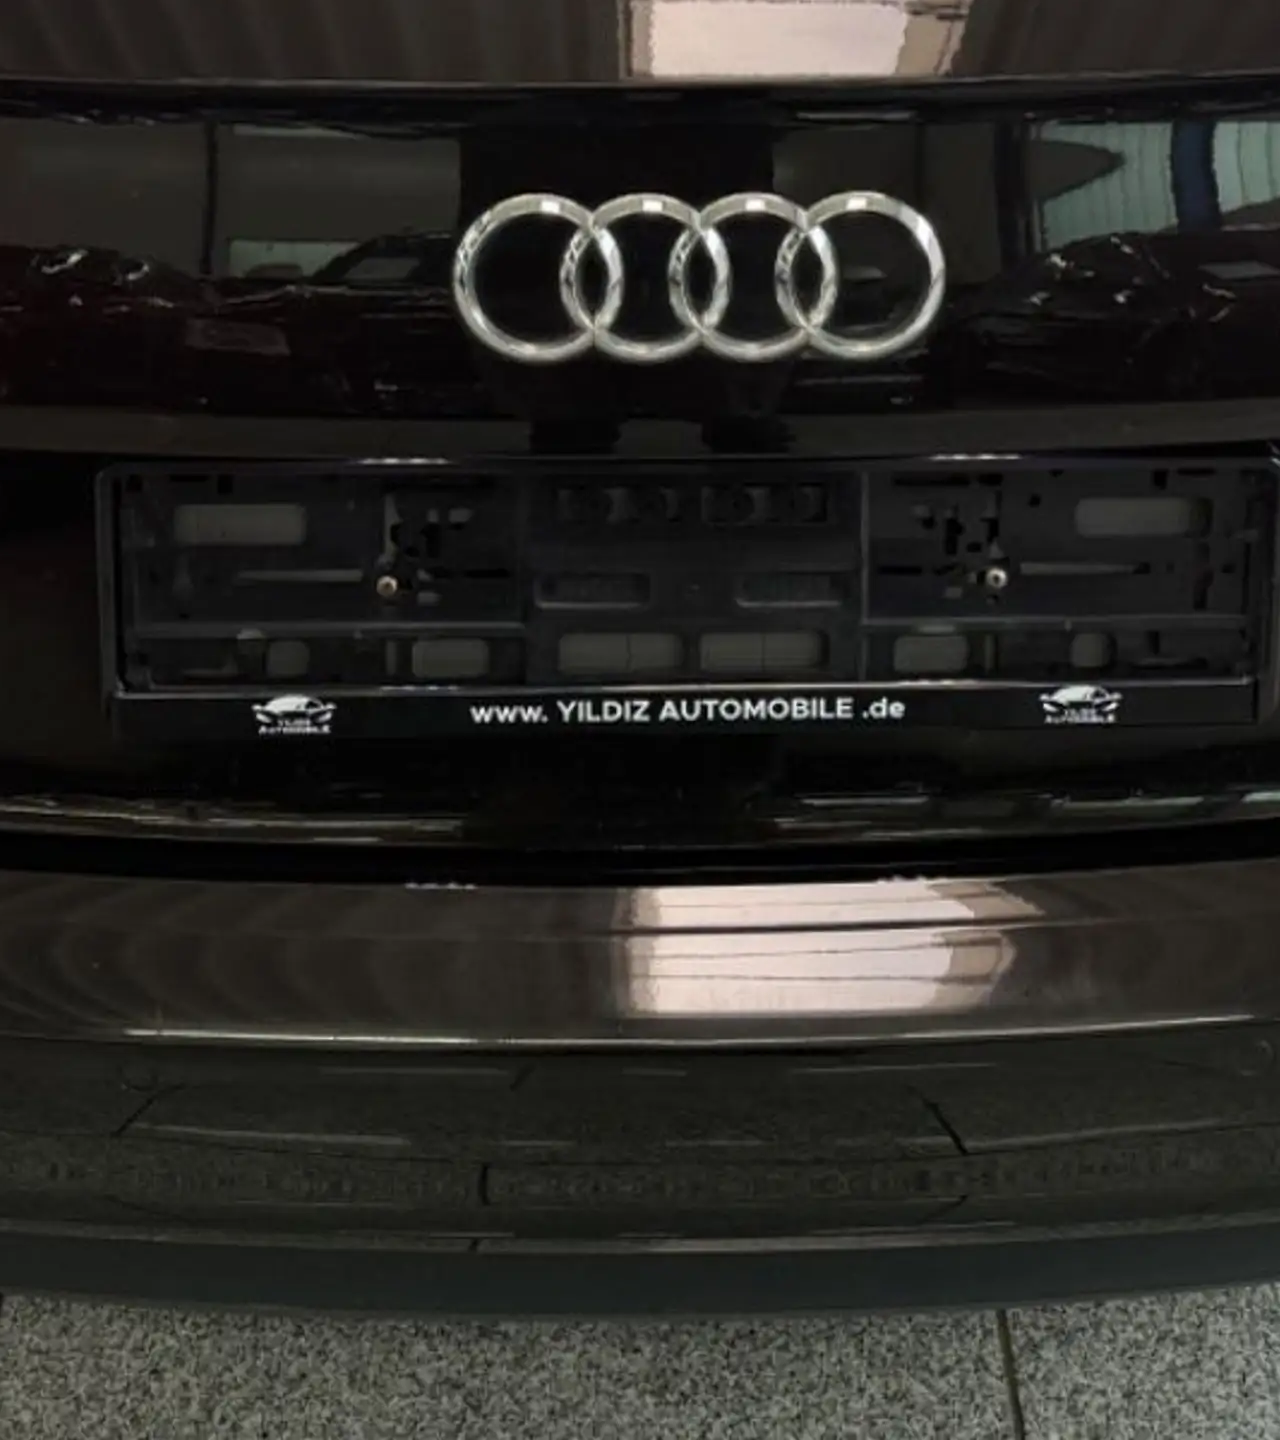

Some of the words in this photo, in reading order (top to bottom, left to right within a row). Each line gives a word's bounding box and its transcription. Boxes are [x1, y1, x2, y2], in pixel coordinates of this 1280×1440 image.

[470, 705, 548, 724] www.
[557, 699, 651, 723] YILDIZ
[659, 697, 854, 722] AUTOMOBILE
[862, 696, 906, 720] .de
